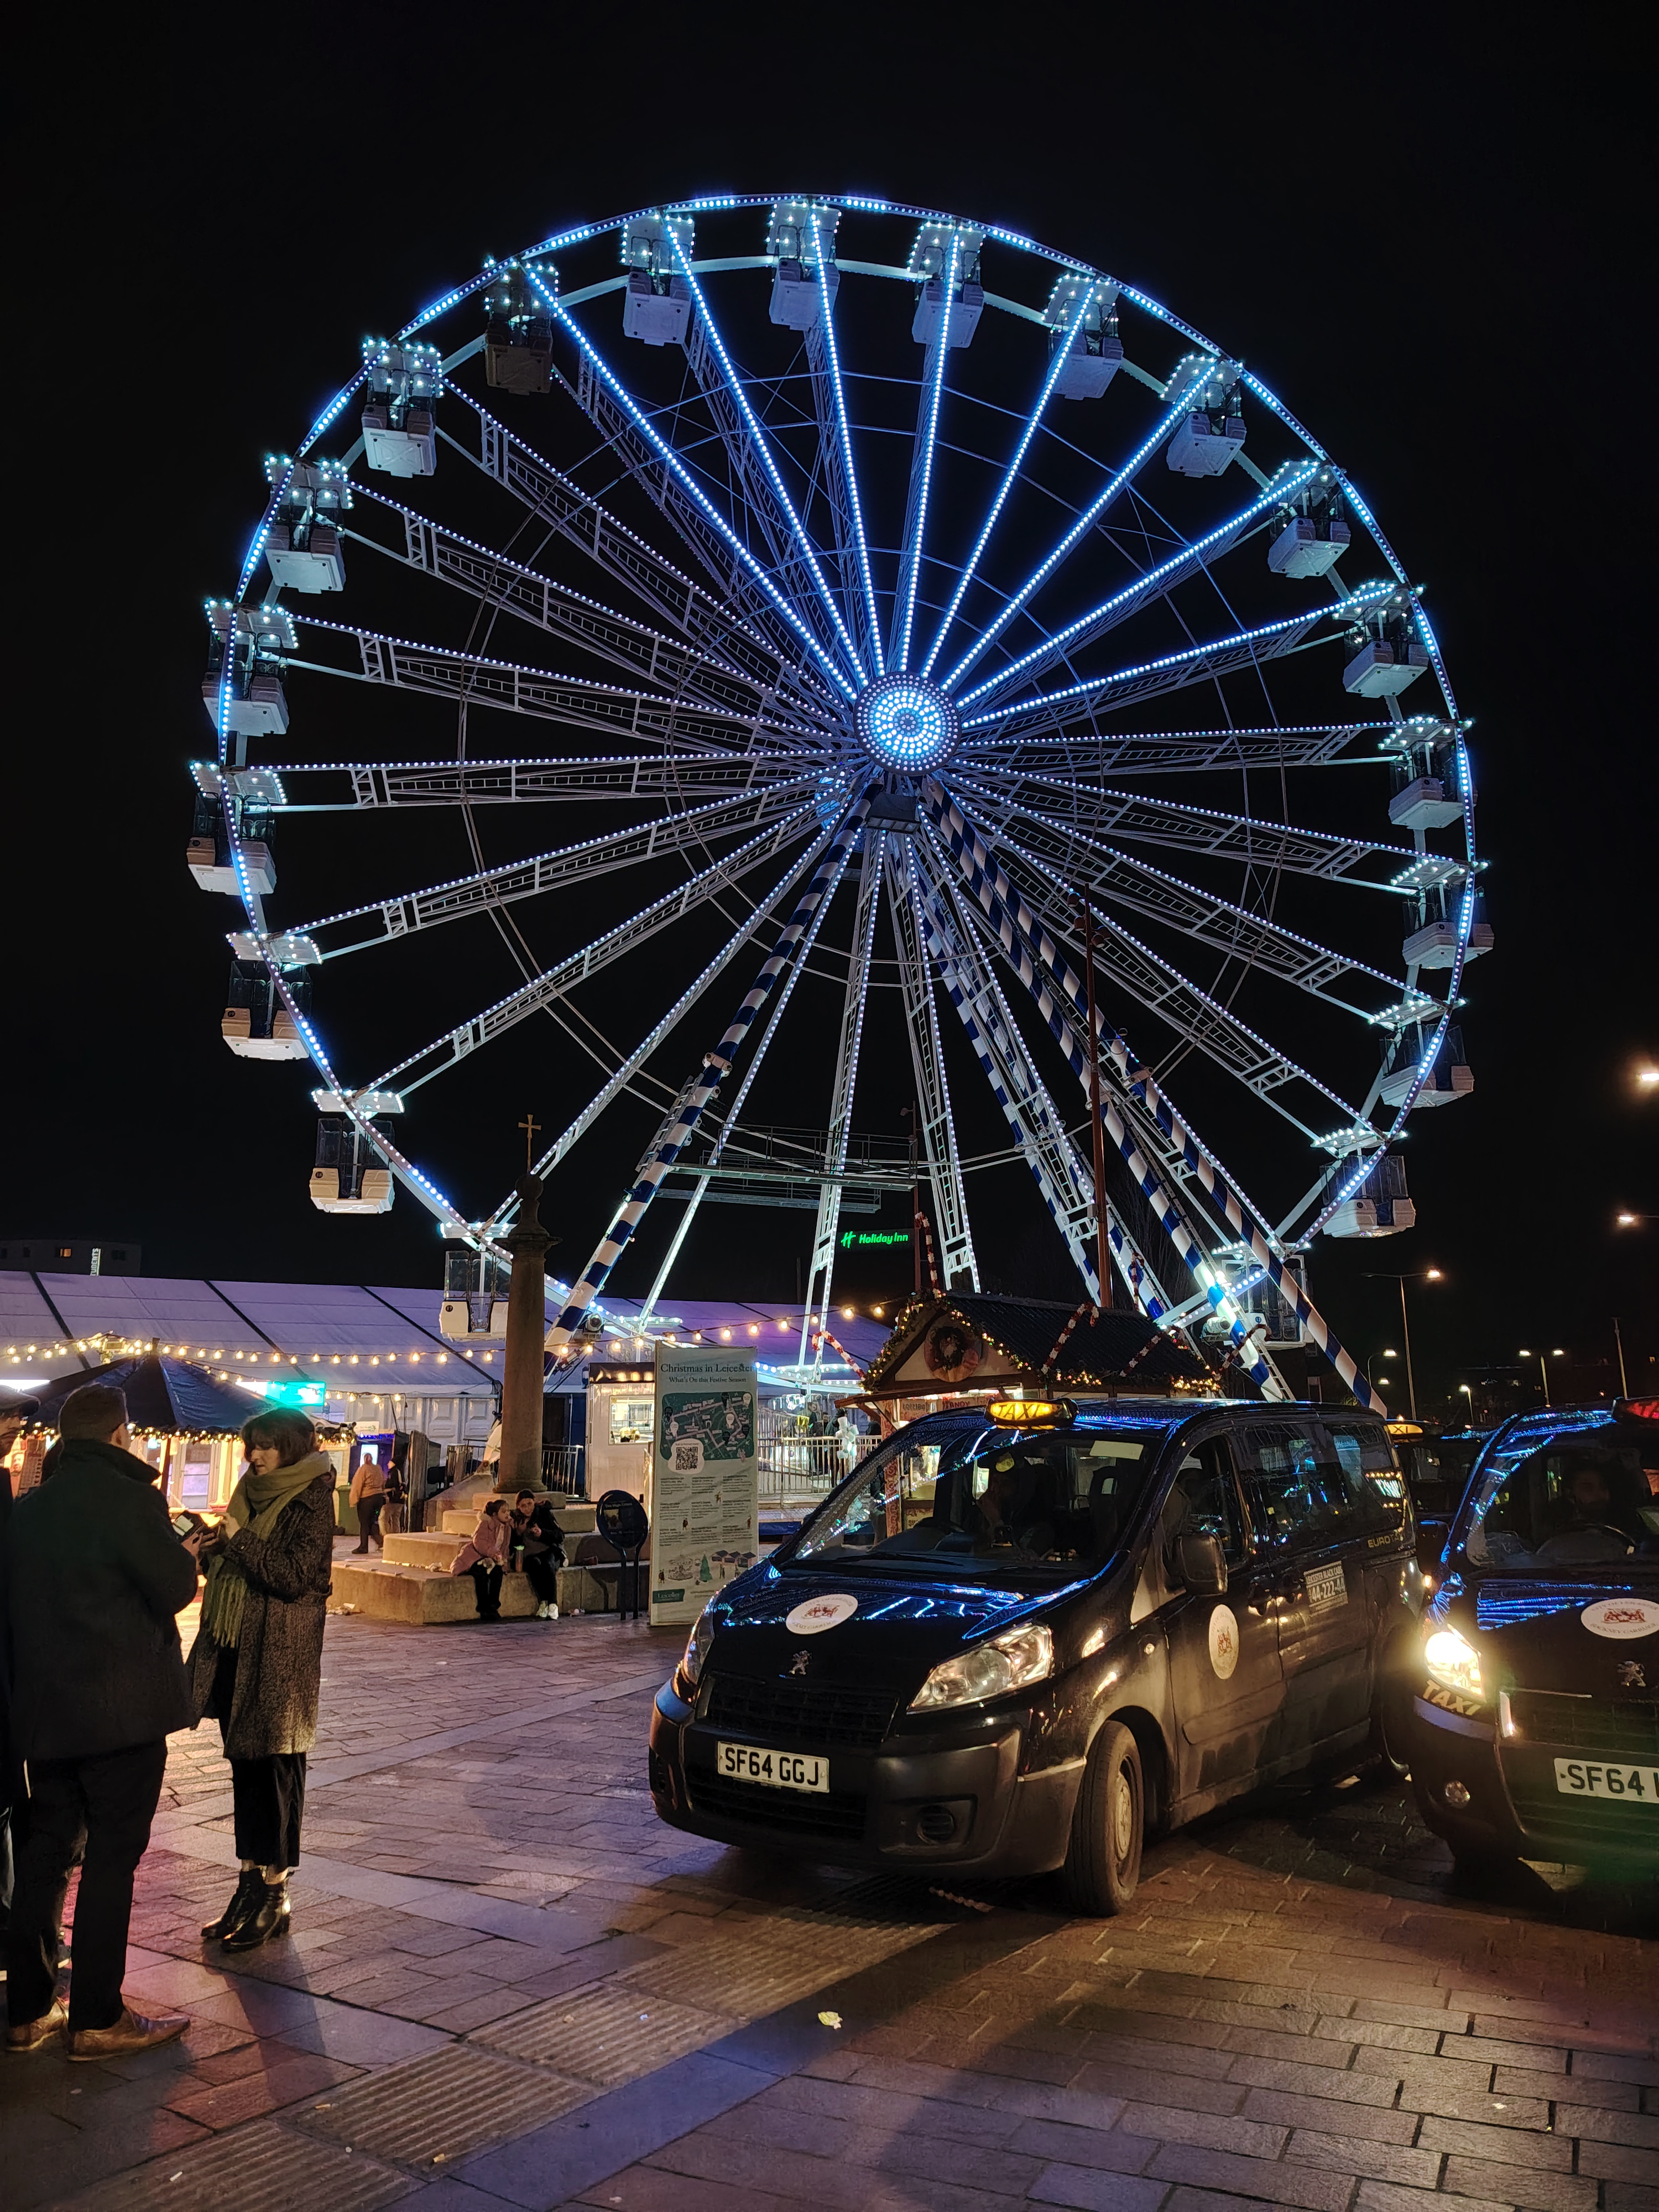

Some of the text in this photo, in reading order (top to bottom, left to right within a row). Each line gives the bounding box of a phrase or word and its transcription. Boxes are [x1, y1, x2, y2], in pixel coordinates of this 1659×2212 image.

[859, 1233, 893, 1245] Holiday
[894, 1232, 908, 1242] Inn
[660, 1363, 753, 1373] Christmas in Leicester
[998, 1404, 1040, 1420] TAXI
[1306, 1566, 1343, 1585] LEICESTER BLACK CABS
[1423, 1679, 1481, 1715] TAXI
[725, 1747, 819, 1786] SF64 GGJ
[1567, 1764, 1645, 1797] SF64
